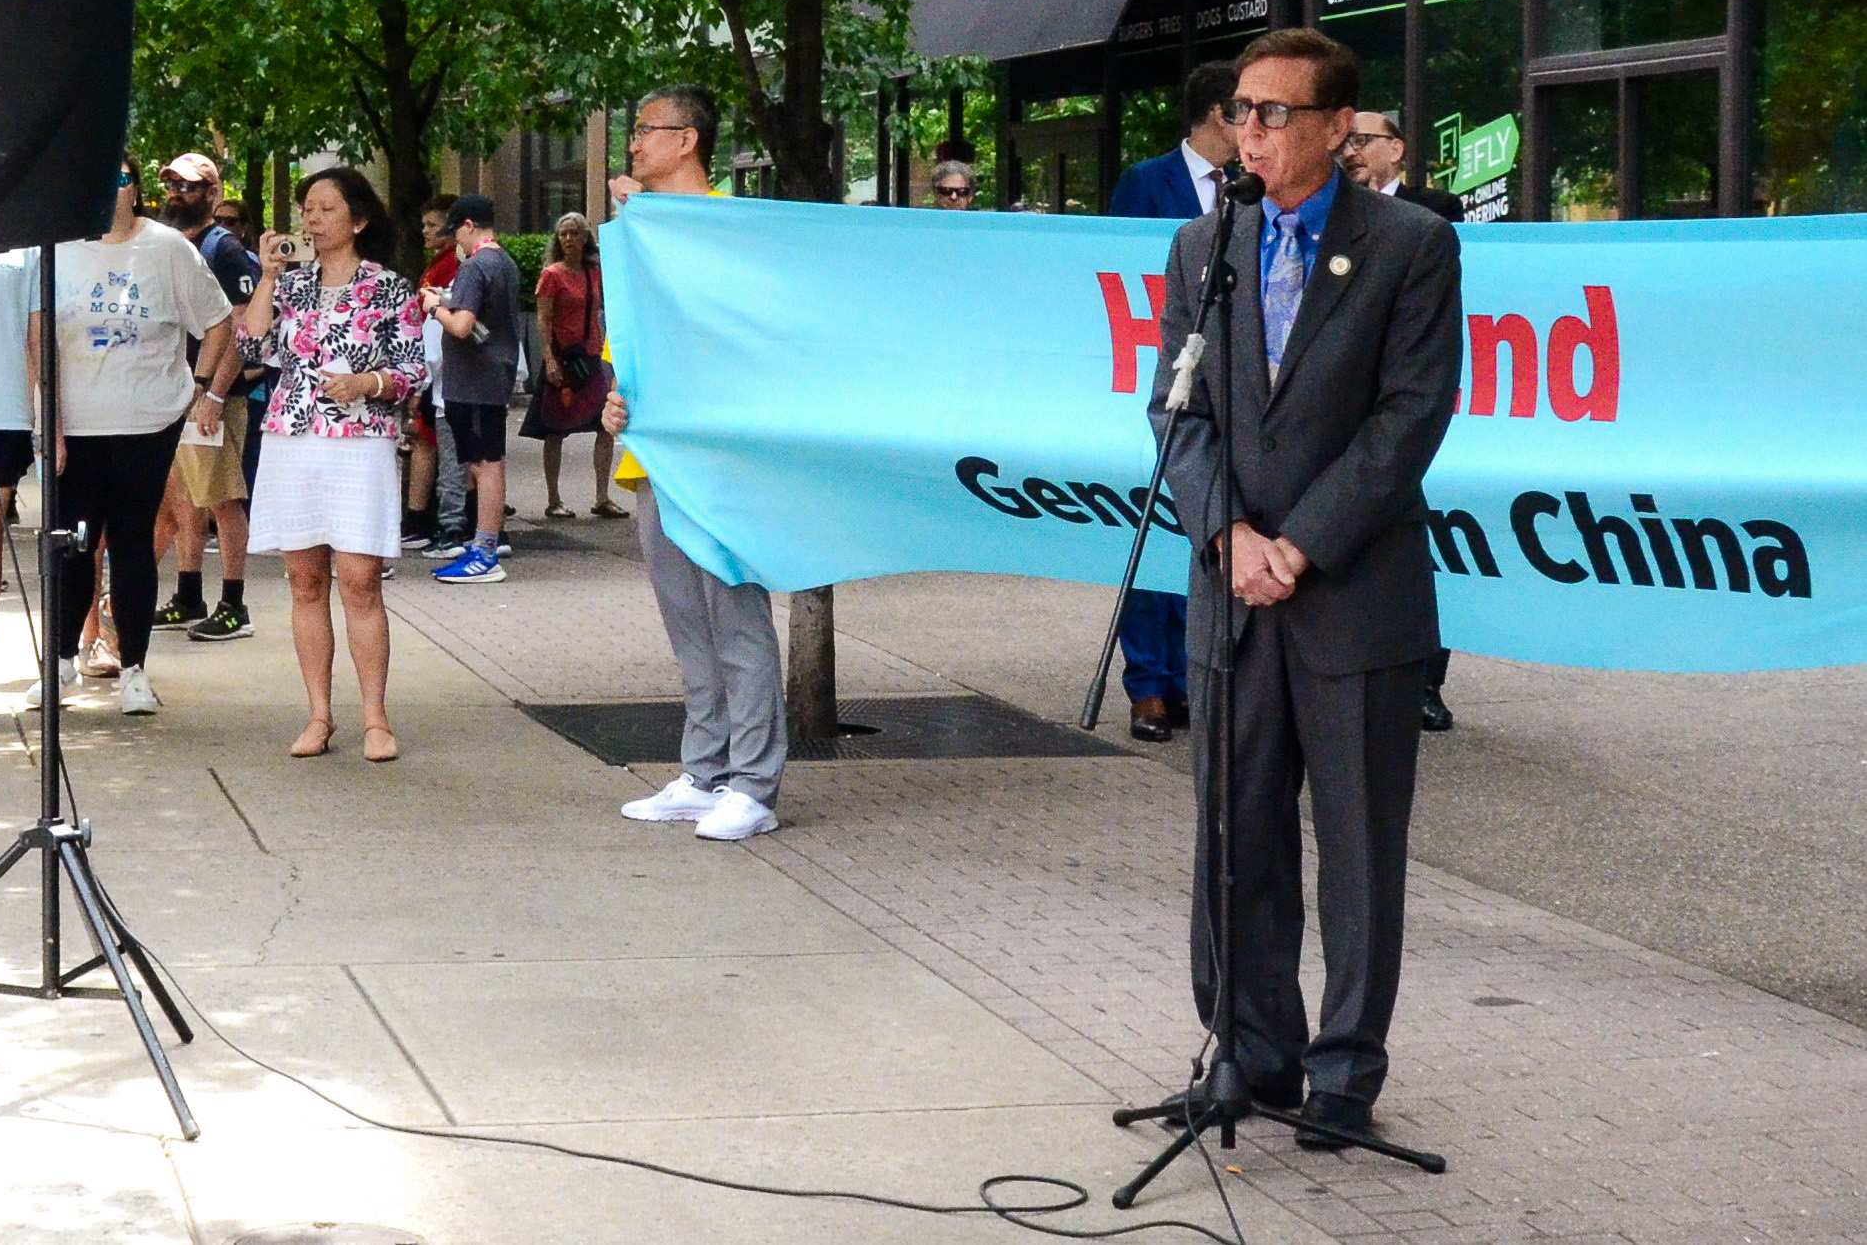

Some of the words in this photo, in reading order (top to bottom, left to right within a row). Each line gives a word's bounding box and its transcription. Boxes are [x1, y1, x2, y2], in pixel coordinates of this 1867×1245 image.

[1196, 8, 1221, 29] DOGS
[1474, 126, 1511, 173] FLY
[1474, 177, 1507, 204] ONLINE
[89, 302, 150, 318] MOVE
[1509, 490, 1813, 599] China
